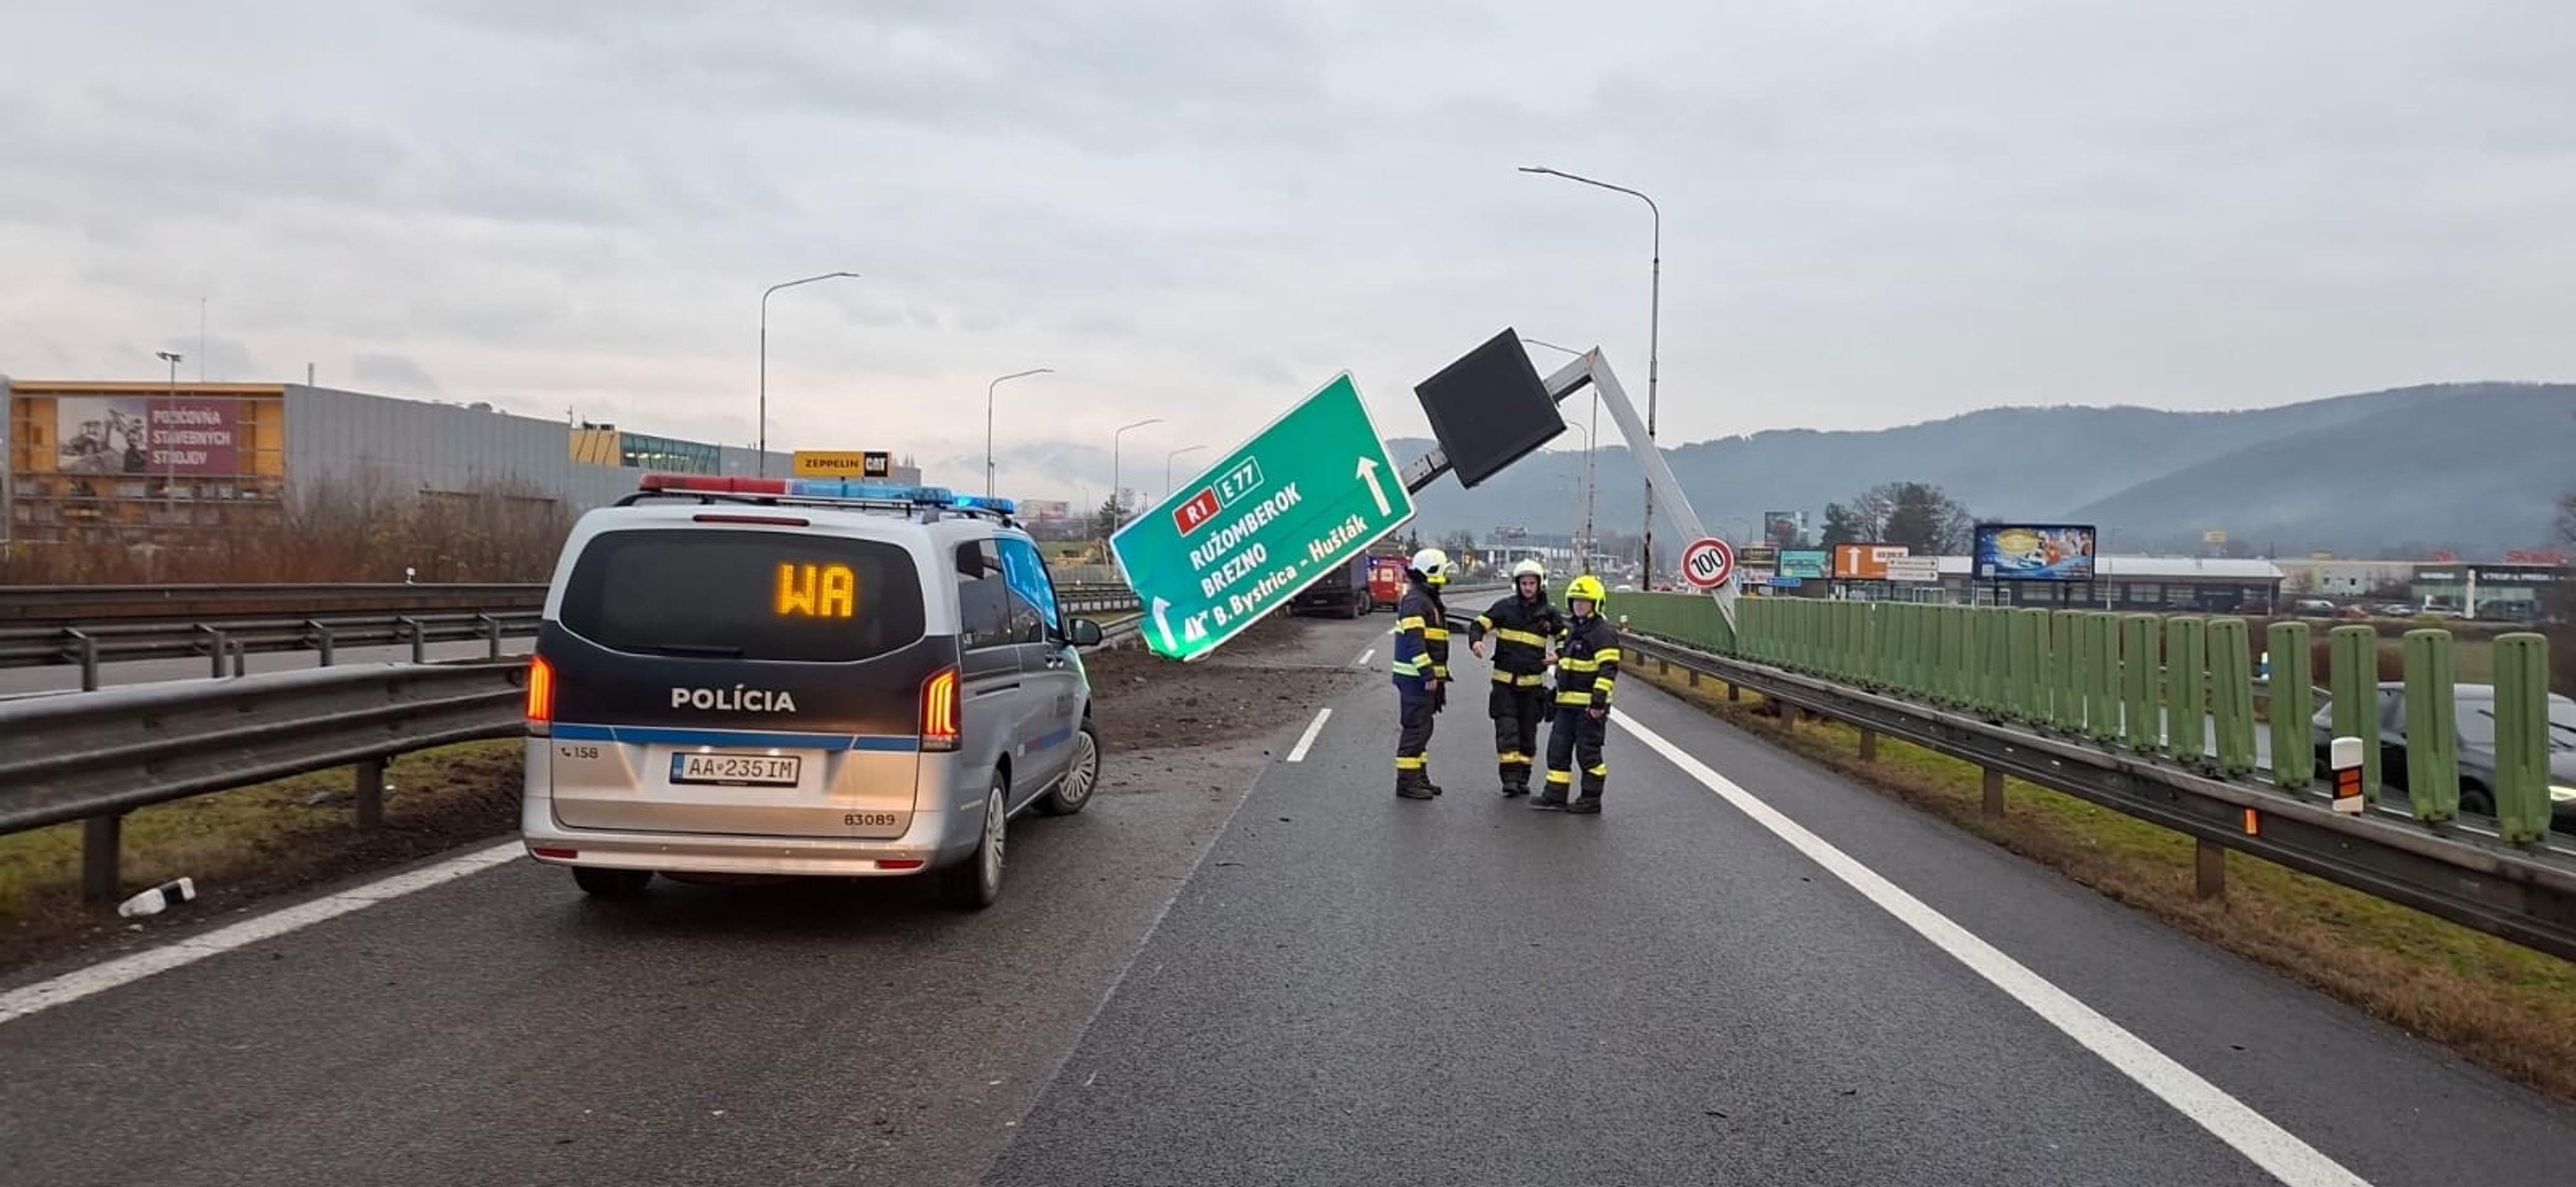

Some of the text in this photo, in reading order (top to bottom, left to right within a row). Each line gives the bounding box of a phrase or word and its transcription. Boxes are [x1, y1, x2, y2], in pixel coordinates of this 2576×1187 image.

[805, 459, 859, 468] ZEPPELIN
[866, 457, 886, 471] CAT
[1221, 464, 1253, 500] E 77
[1186, 498, 1208, 524] R1
[1189, 481, 1302, 572] RUŽOMBEROK
[1201, 542, 1268, 599] BREZNO
[1690, 549, 1724, 576] 100
[776, 563, 855, 617] WA
[671, 684, 796, 712] POLÍCIA
[574, 747, 599, 759] 158
[844, 814, 896, 825] 83089
